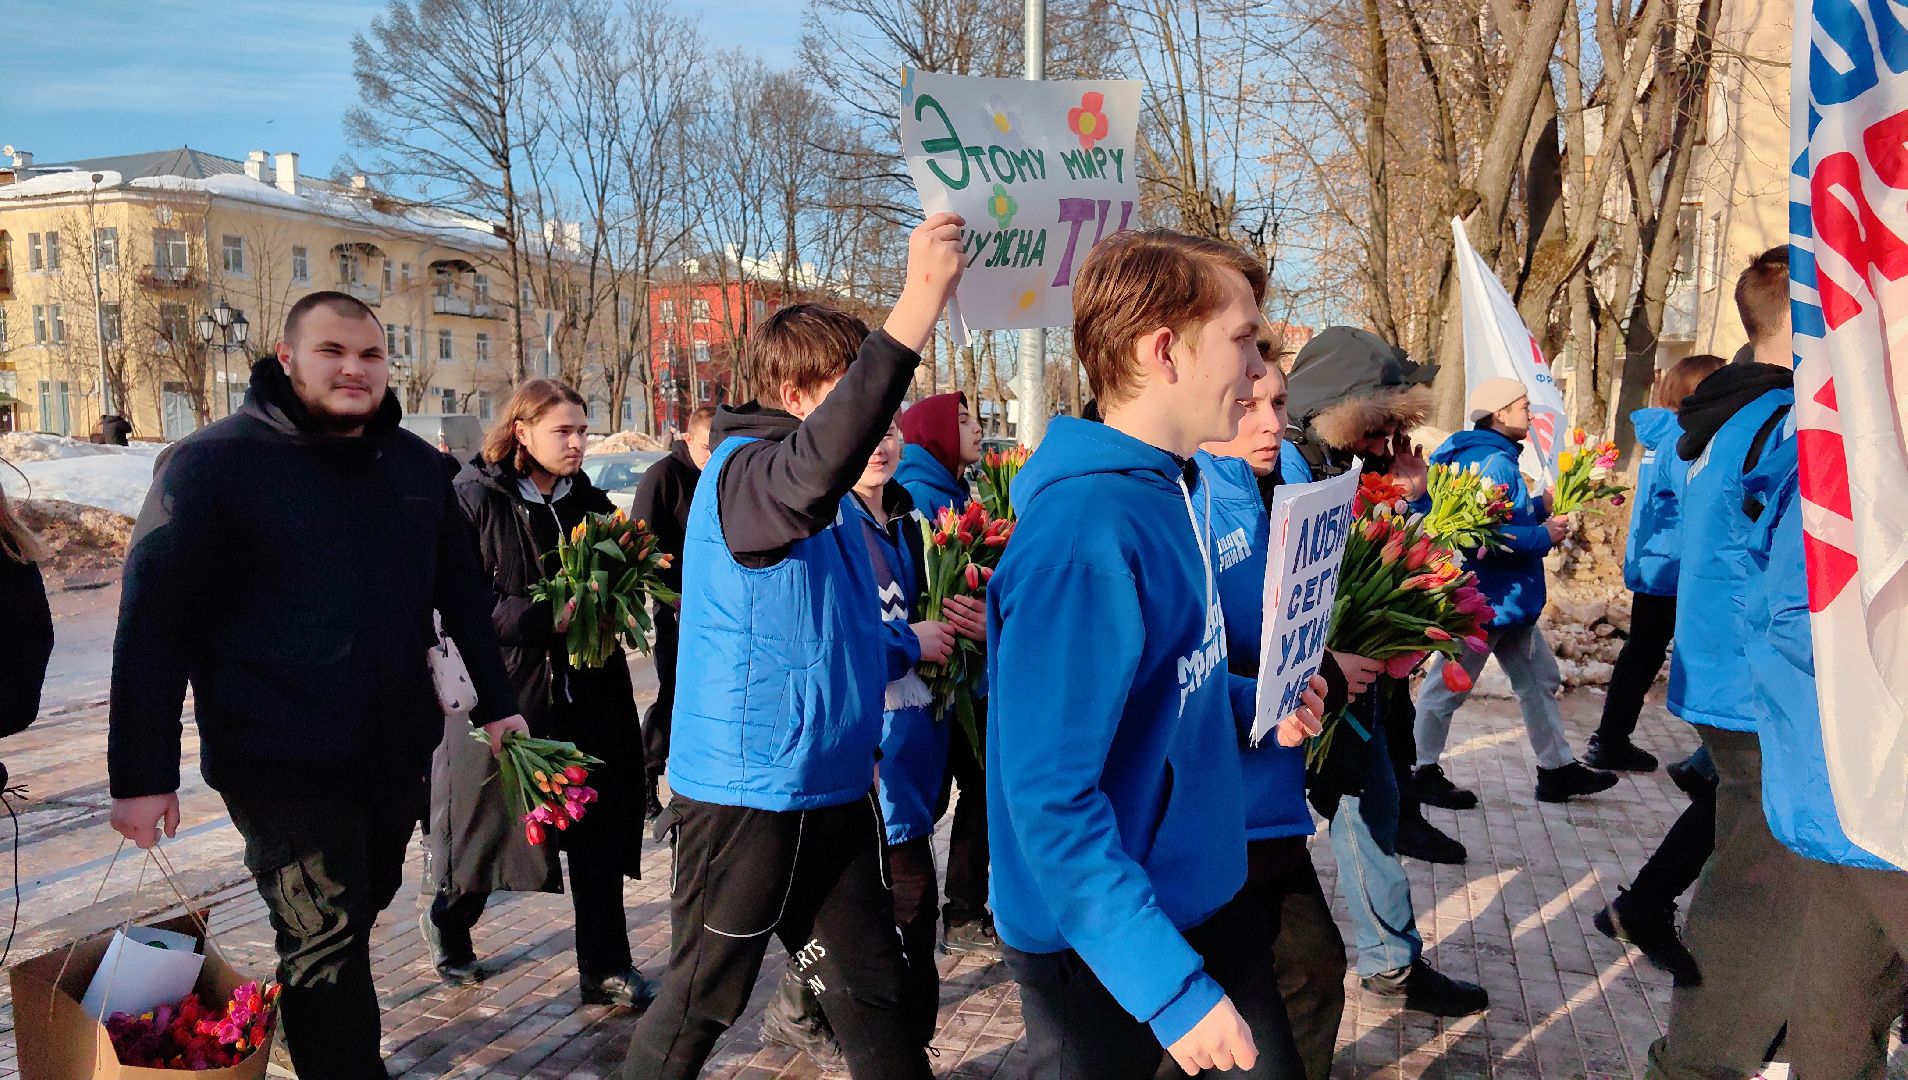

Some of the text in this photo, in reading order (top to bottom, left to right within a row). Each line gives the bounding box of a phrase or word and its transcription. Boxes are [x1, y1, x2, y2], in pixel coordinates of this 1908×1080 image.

[1060, 146, 1124, 184] МИРУ
[1292, 498, 1354, 575] ЛЮБИ
[1276, 664, 1321, 720] МЕ
